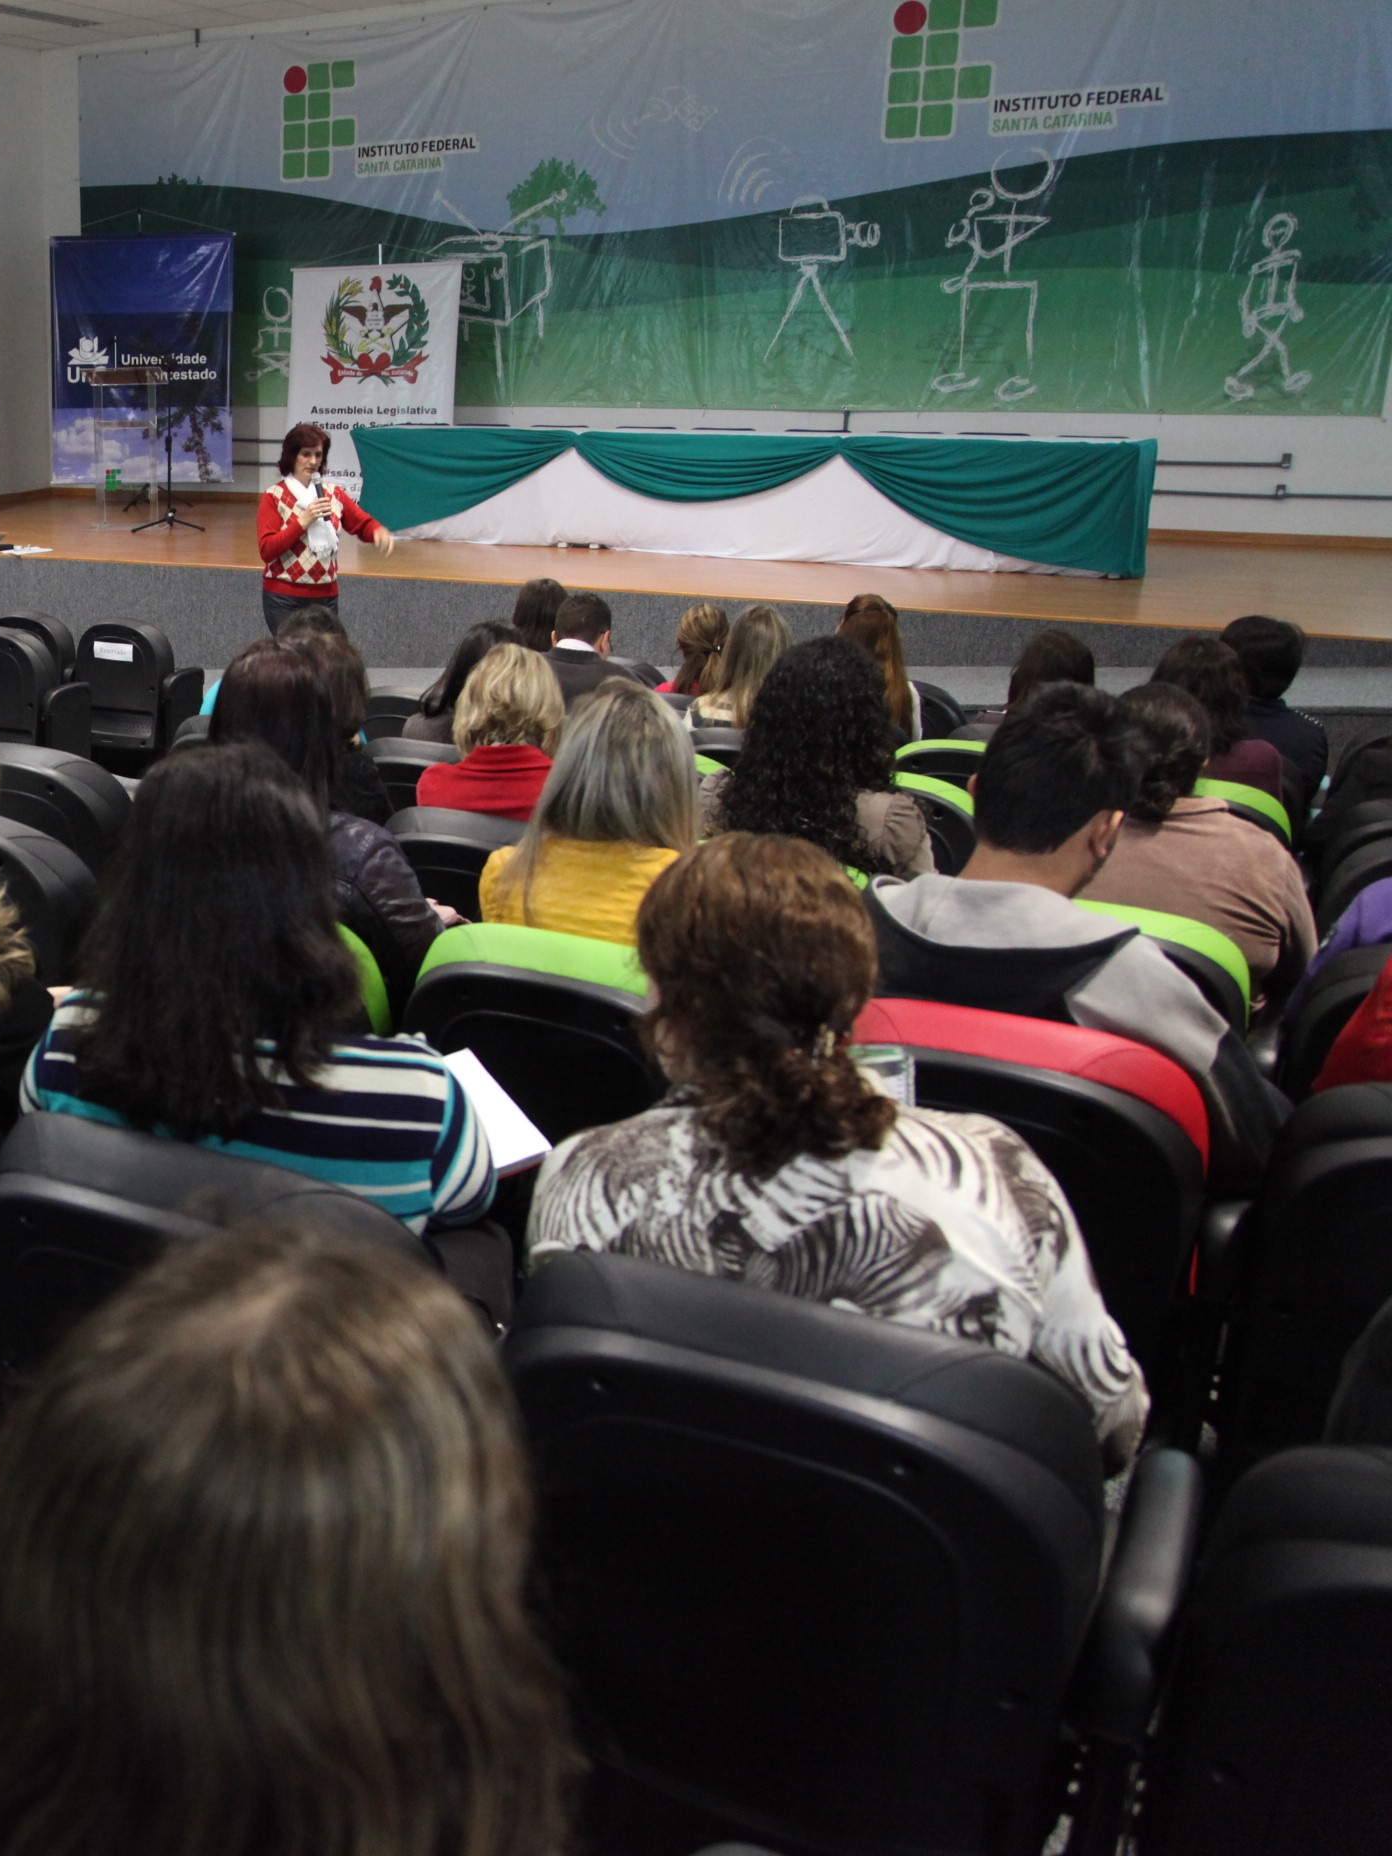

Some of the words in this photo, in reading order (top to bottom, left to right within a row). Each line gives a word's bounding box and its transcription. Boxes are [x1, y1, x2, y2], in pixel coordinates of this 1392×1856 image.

[993, 93, 1082, 113] INSTITUTO
[1086, 87, 1164, 106] FEDERAL
[992, 117, 1038, 133] SANTA
[1042, 111, 1112, 130] CATARINA
[358, 143, 419, 158] INSTITUTO
[421, 137, 476, 153] FEDERAL
[357, 160, 390, 174] SANTA
[394, 156, 442, 171] CATARINA
[311, 406, 373, 415] Assembleia
[377, 406, 437, 417] Legislativa
[312, 421, 349, 430] Estado
